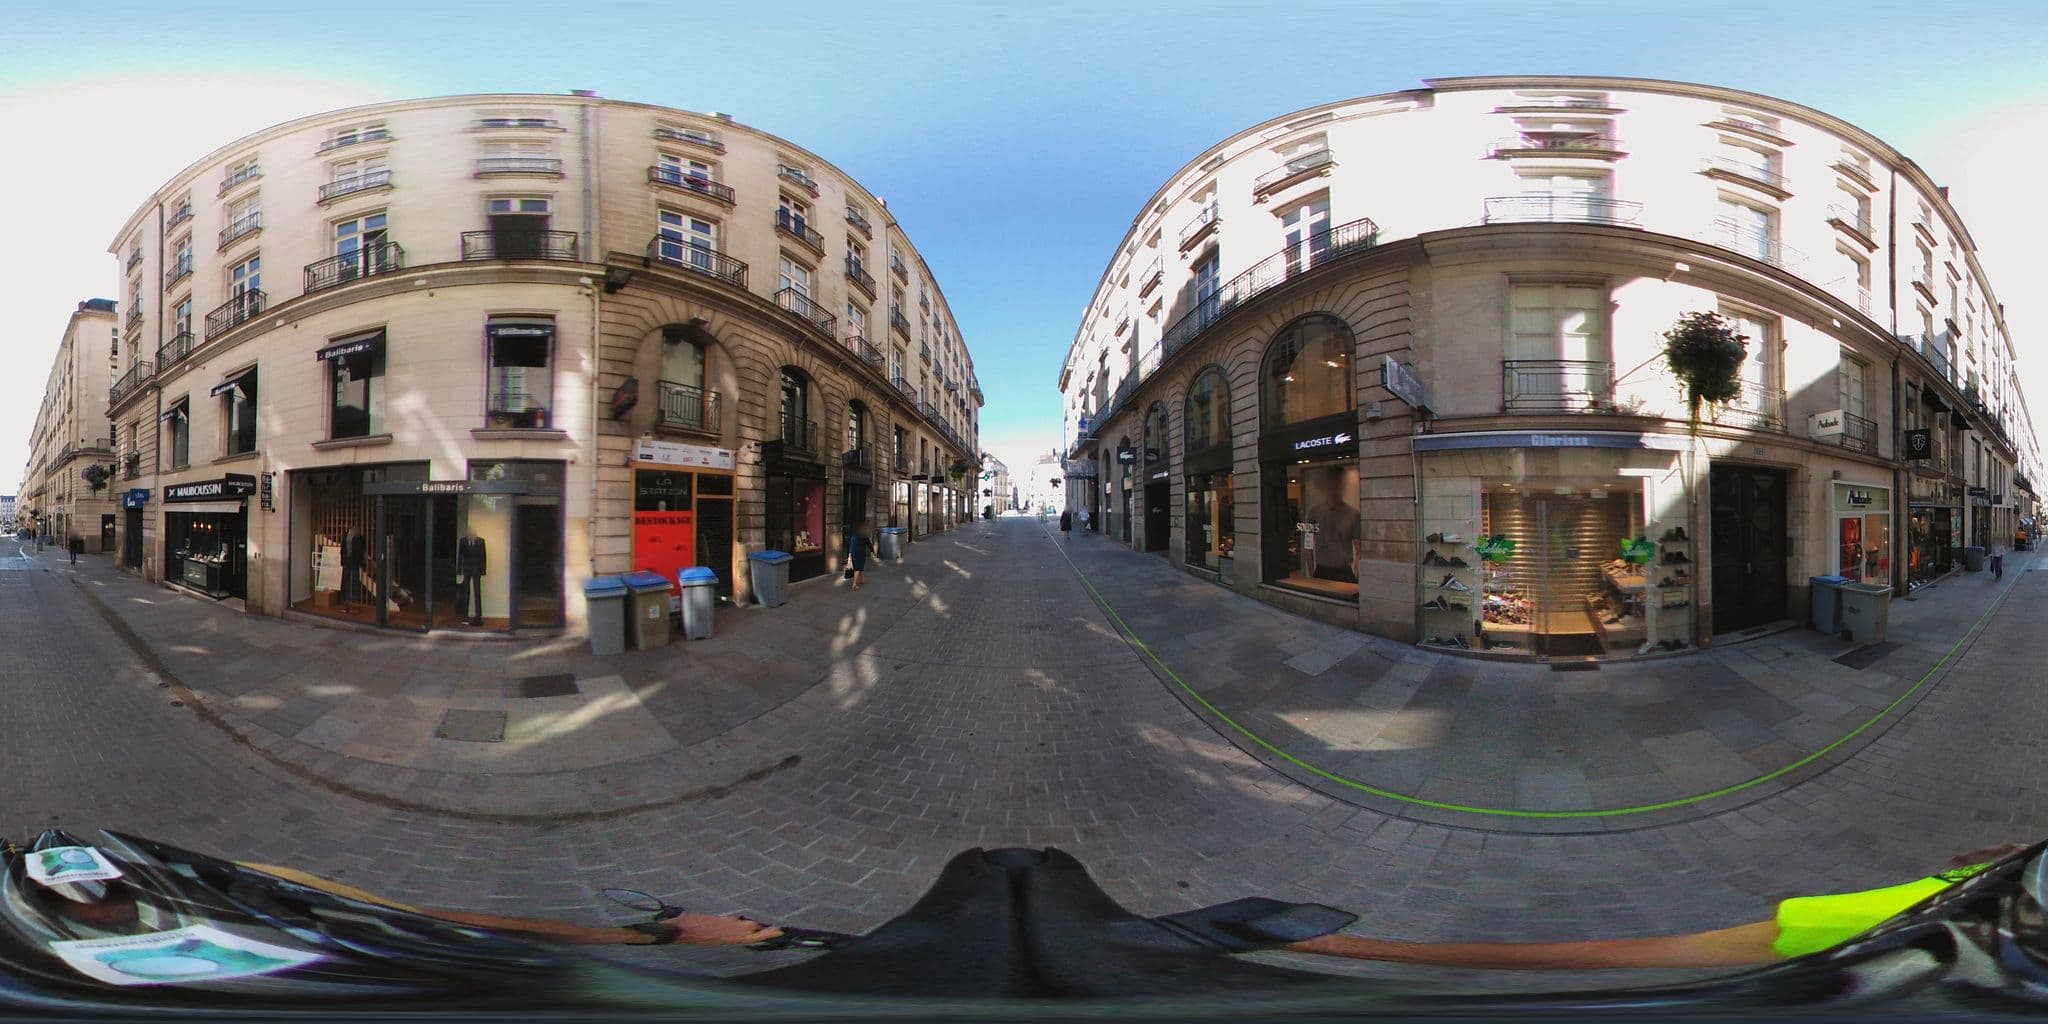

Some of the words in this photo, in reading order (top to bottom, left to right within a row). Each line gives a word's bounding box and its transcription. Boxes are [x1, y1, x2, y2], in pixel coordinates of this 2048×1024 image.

[325, 344, 363, 359] Balibaris
[1295, 437, 1333, 450] LACOSTE
[177, 484, 222, 497] MAUBOUSSIN
[422, 483, 464, 492] Balibaris
[640, 487, 688, 496] STATION
